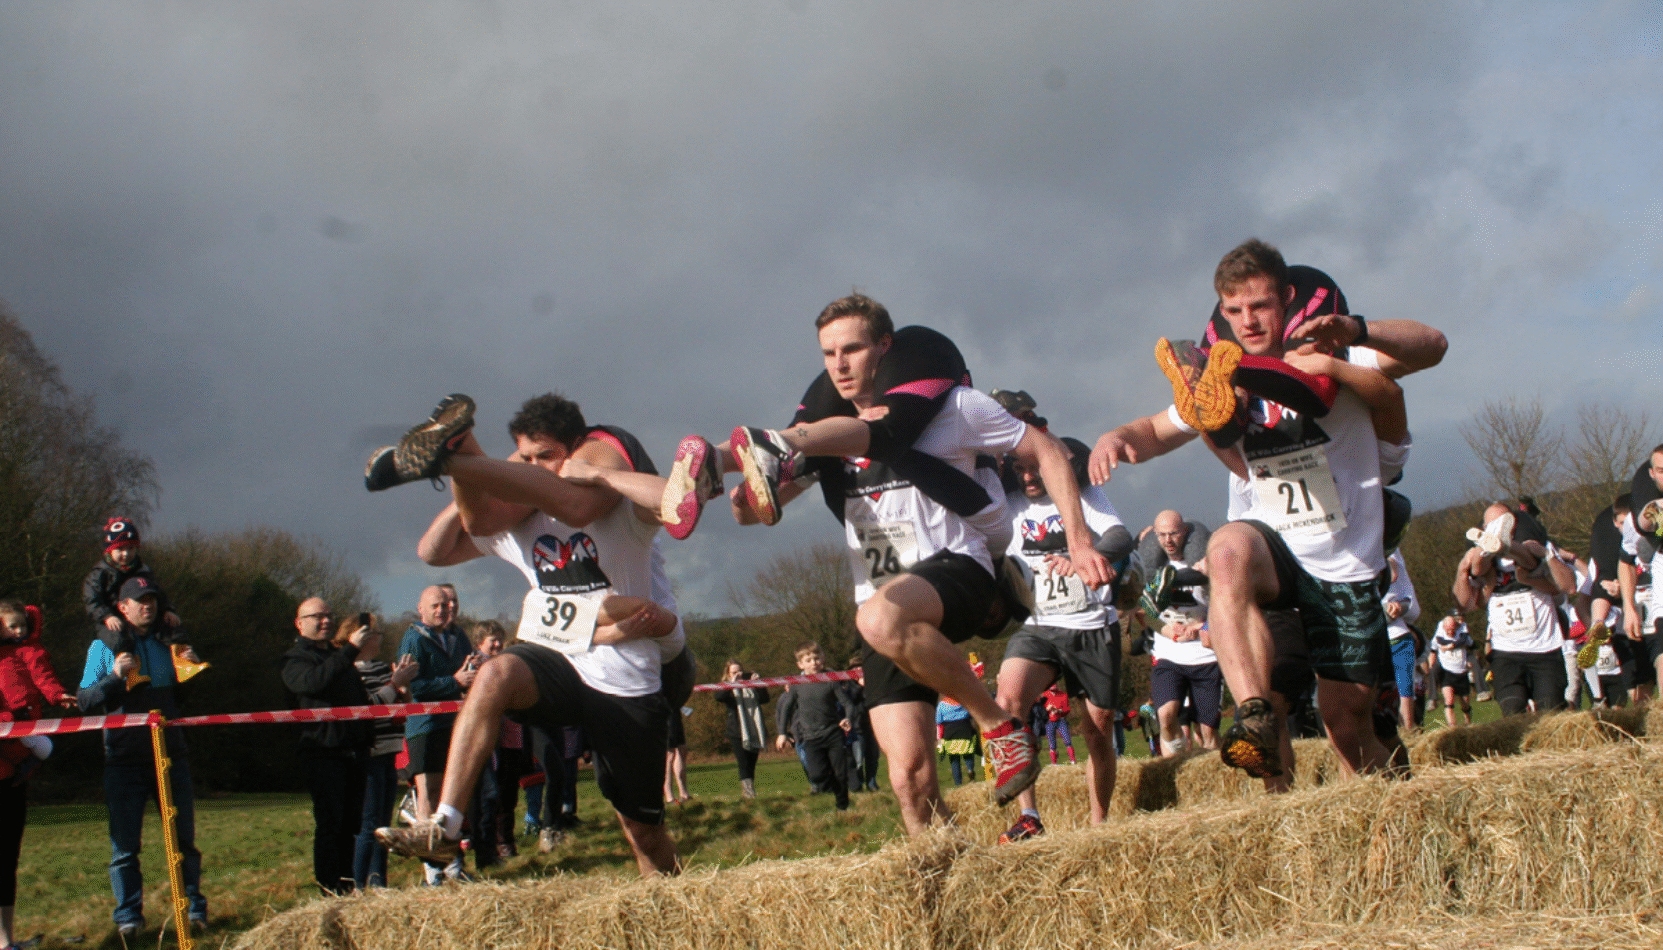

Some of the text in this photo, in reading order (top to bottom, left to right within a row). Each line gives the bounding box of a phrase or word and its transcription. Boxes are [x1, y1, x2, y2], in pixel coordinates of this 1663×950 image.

[1272, 442, 1304, 453] Carrying
[865, 482, 892, 493] Carrying
[1278, 477, 1313, 514] 21
[865, 546, 900, 579] 26
[1044, 576, 1068, 601] 24
[541, 596, 577, 632] 39
[1505, 607, 1523, 626] 34
